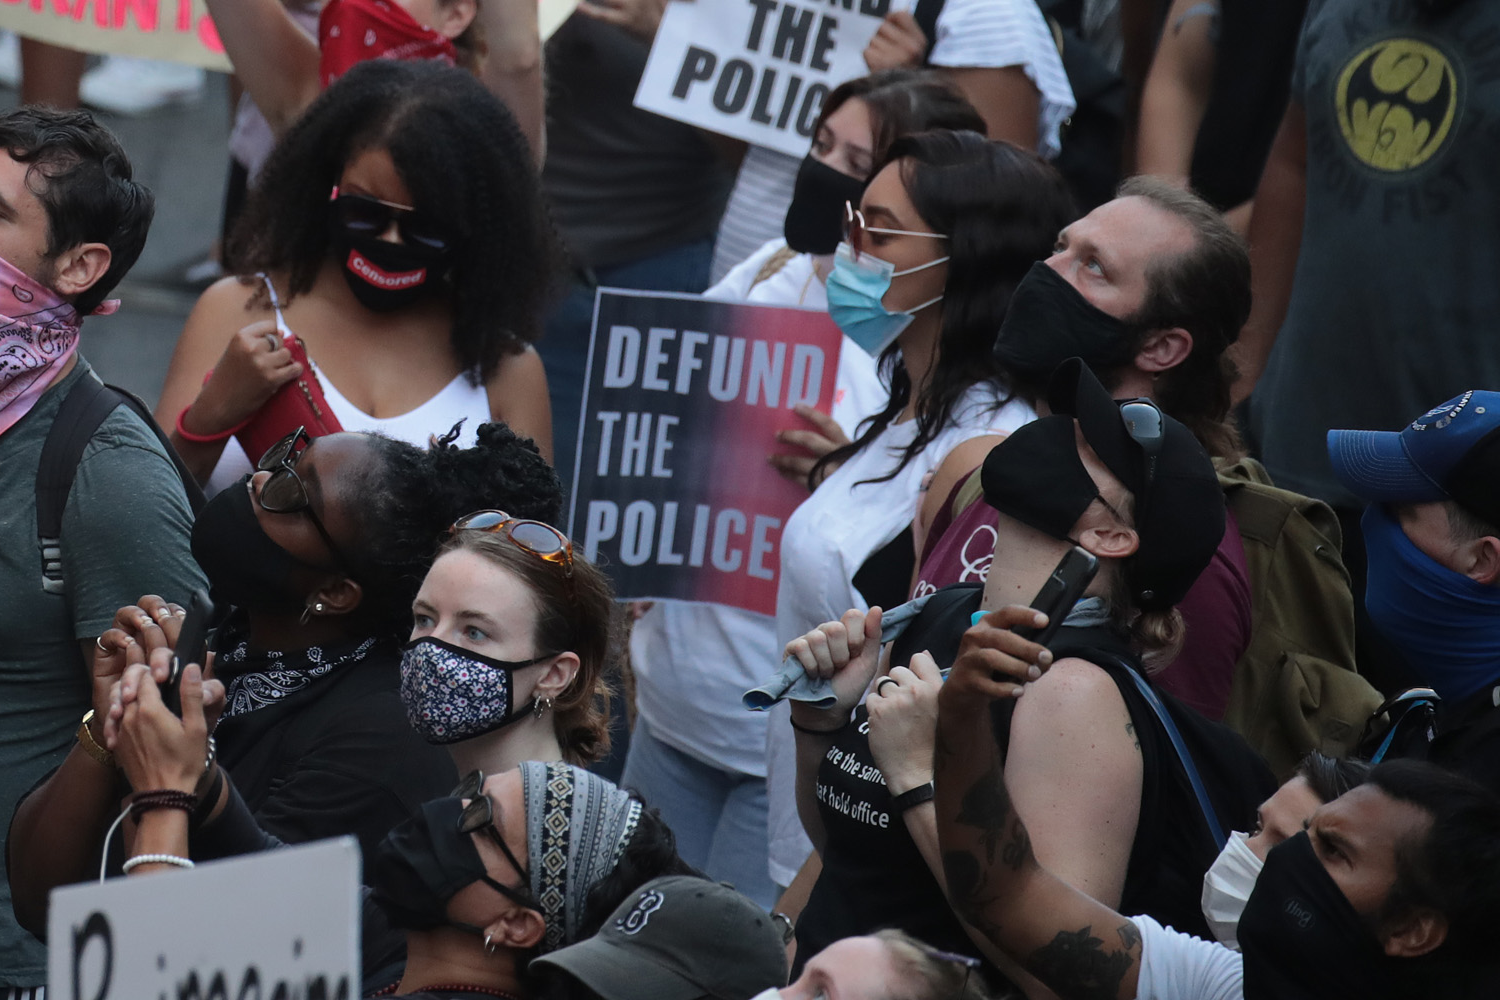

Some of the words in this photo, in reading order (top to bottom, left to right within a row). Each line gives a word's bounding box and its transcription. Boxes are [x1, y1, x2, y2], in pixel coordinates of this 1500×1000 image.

[671, 45, 831, 139] POLIC
[352, 256, 423, 287] Censored
[602, 324, 826, 411] DEFUND
[596, 410, 680, 478] THE
[583, 499, 782, 581] POLICE
[840, 752, 861, 775] the
[828, 785, 851, 815] hold
[851, 800, 890, 829] office
[615, 889, 664, 936] B
